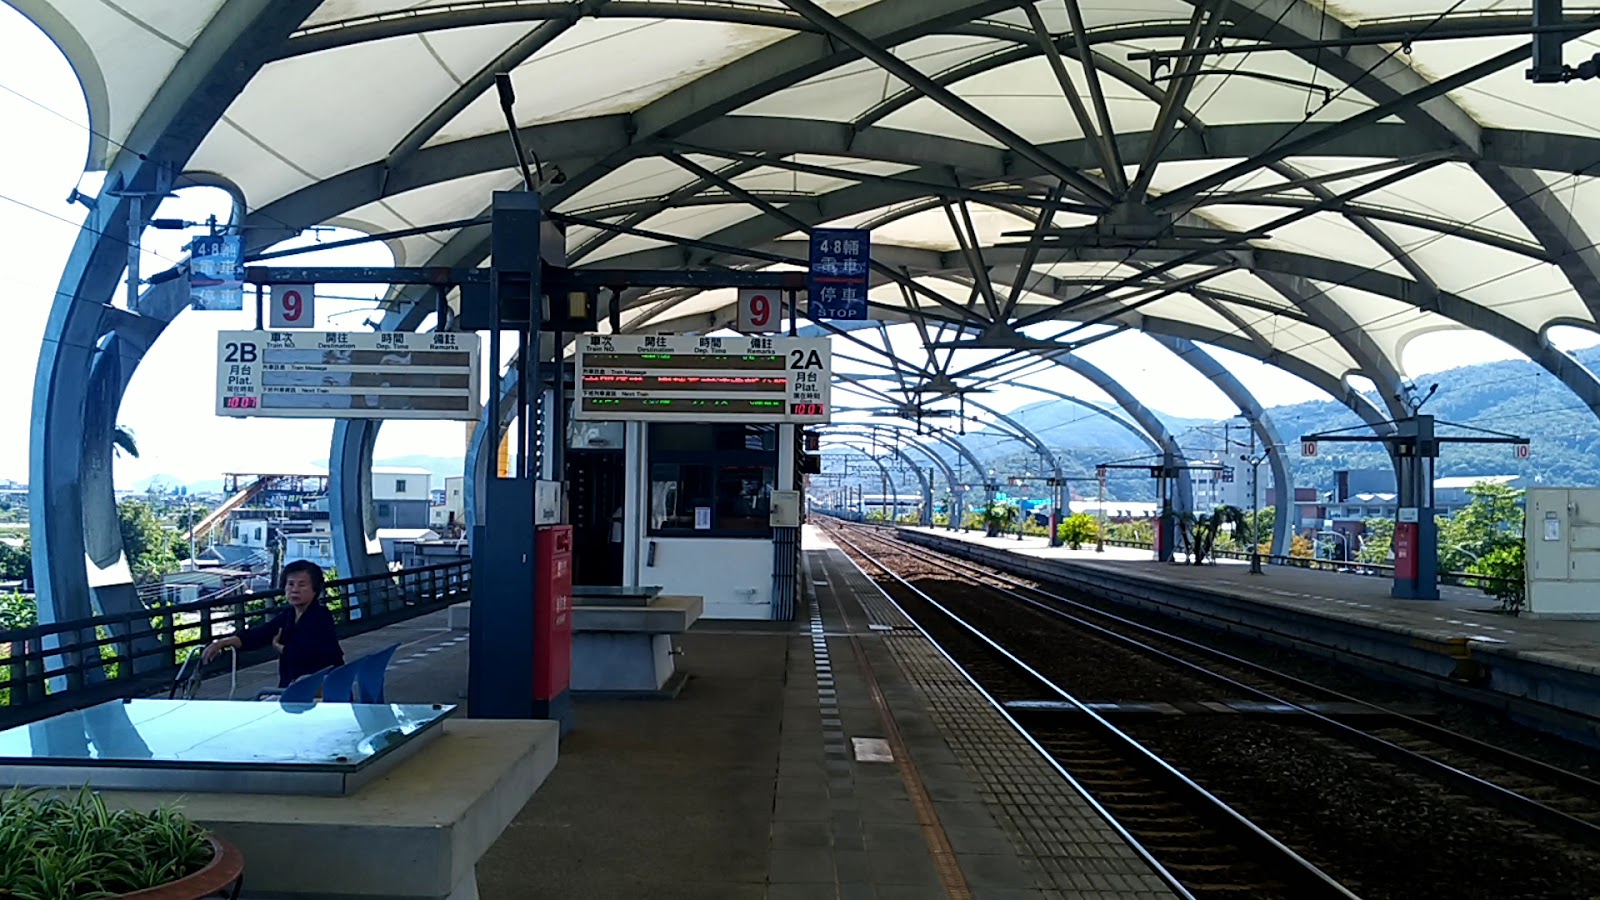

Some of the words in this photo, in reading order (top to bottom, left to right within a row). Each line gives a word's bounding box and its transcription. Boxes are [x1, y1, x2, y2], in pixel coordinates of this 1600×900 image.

[821, 257, 858, 275] 電車
[820, 286, 857, 303] 停車
[282, 290, 302, 321] 9
[750, 295, 770, 326] 9
[818, 309, 857, 318] STOP
[271, 332, 293, 343] 車次
[325, 332, 348, 343] 開往
[381, 333, 404, 344] 時間
[434, 334, 456, 345] 備註
[590, 336, 612, 347] 車次
[645, 337, 667, 347] 開往
[700, 338, 722, 348] 時間
[750, 338, 773, 349] 備註
[224, 342, 258, 362] 2B
[790, 350, 823, 369] 2A
[230, 365, 252, 375] 月台
[228, 376, 253, 385] Plat.
[796, 372, 817, 382] 月台
[795, 383, 819, 392] Plat.
[1303, 442, 1315, 455] 10
[1516, 445, 1527, 457] 10
